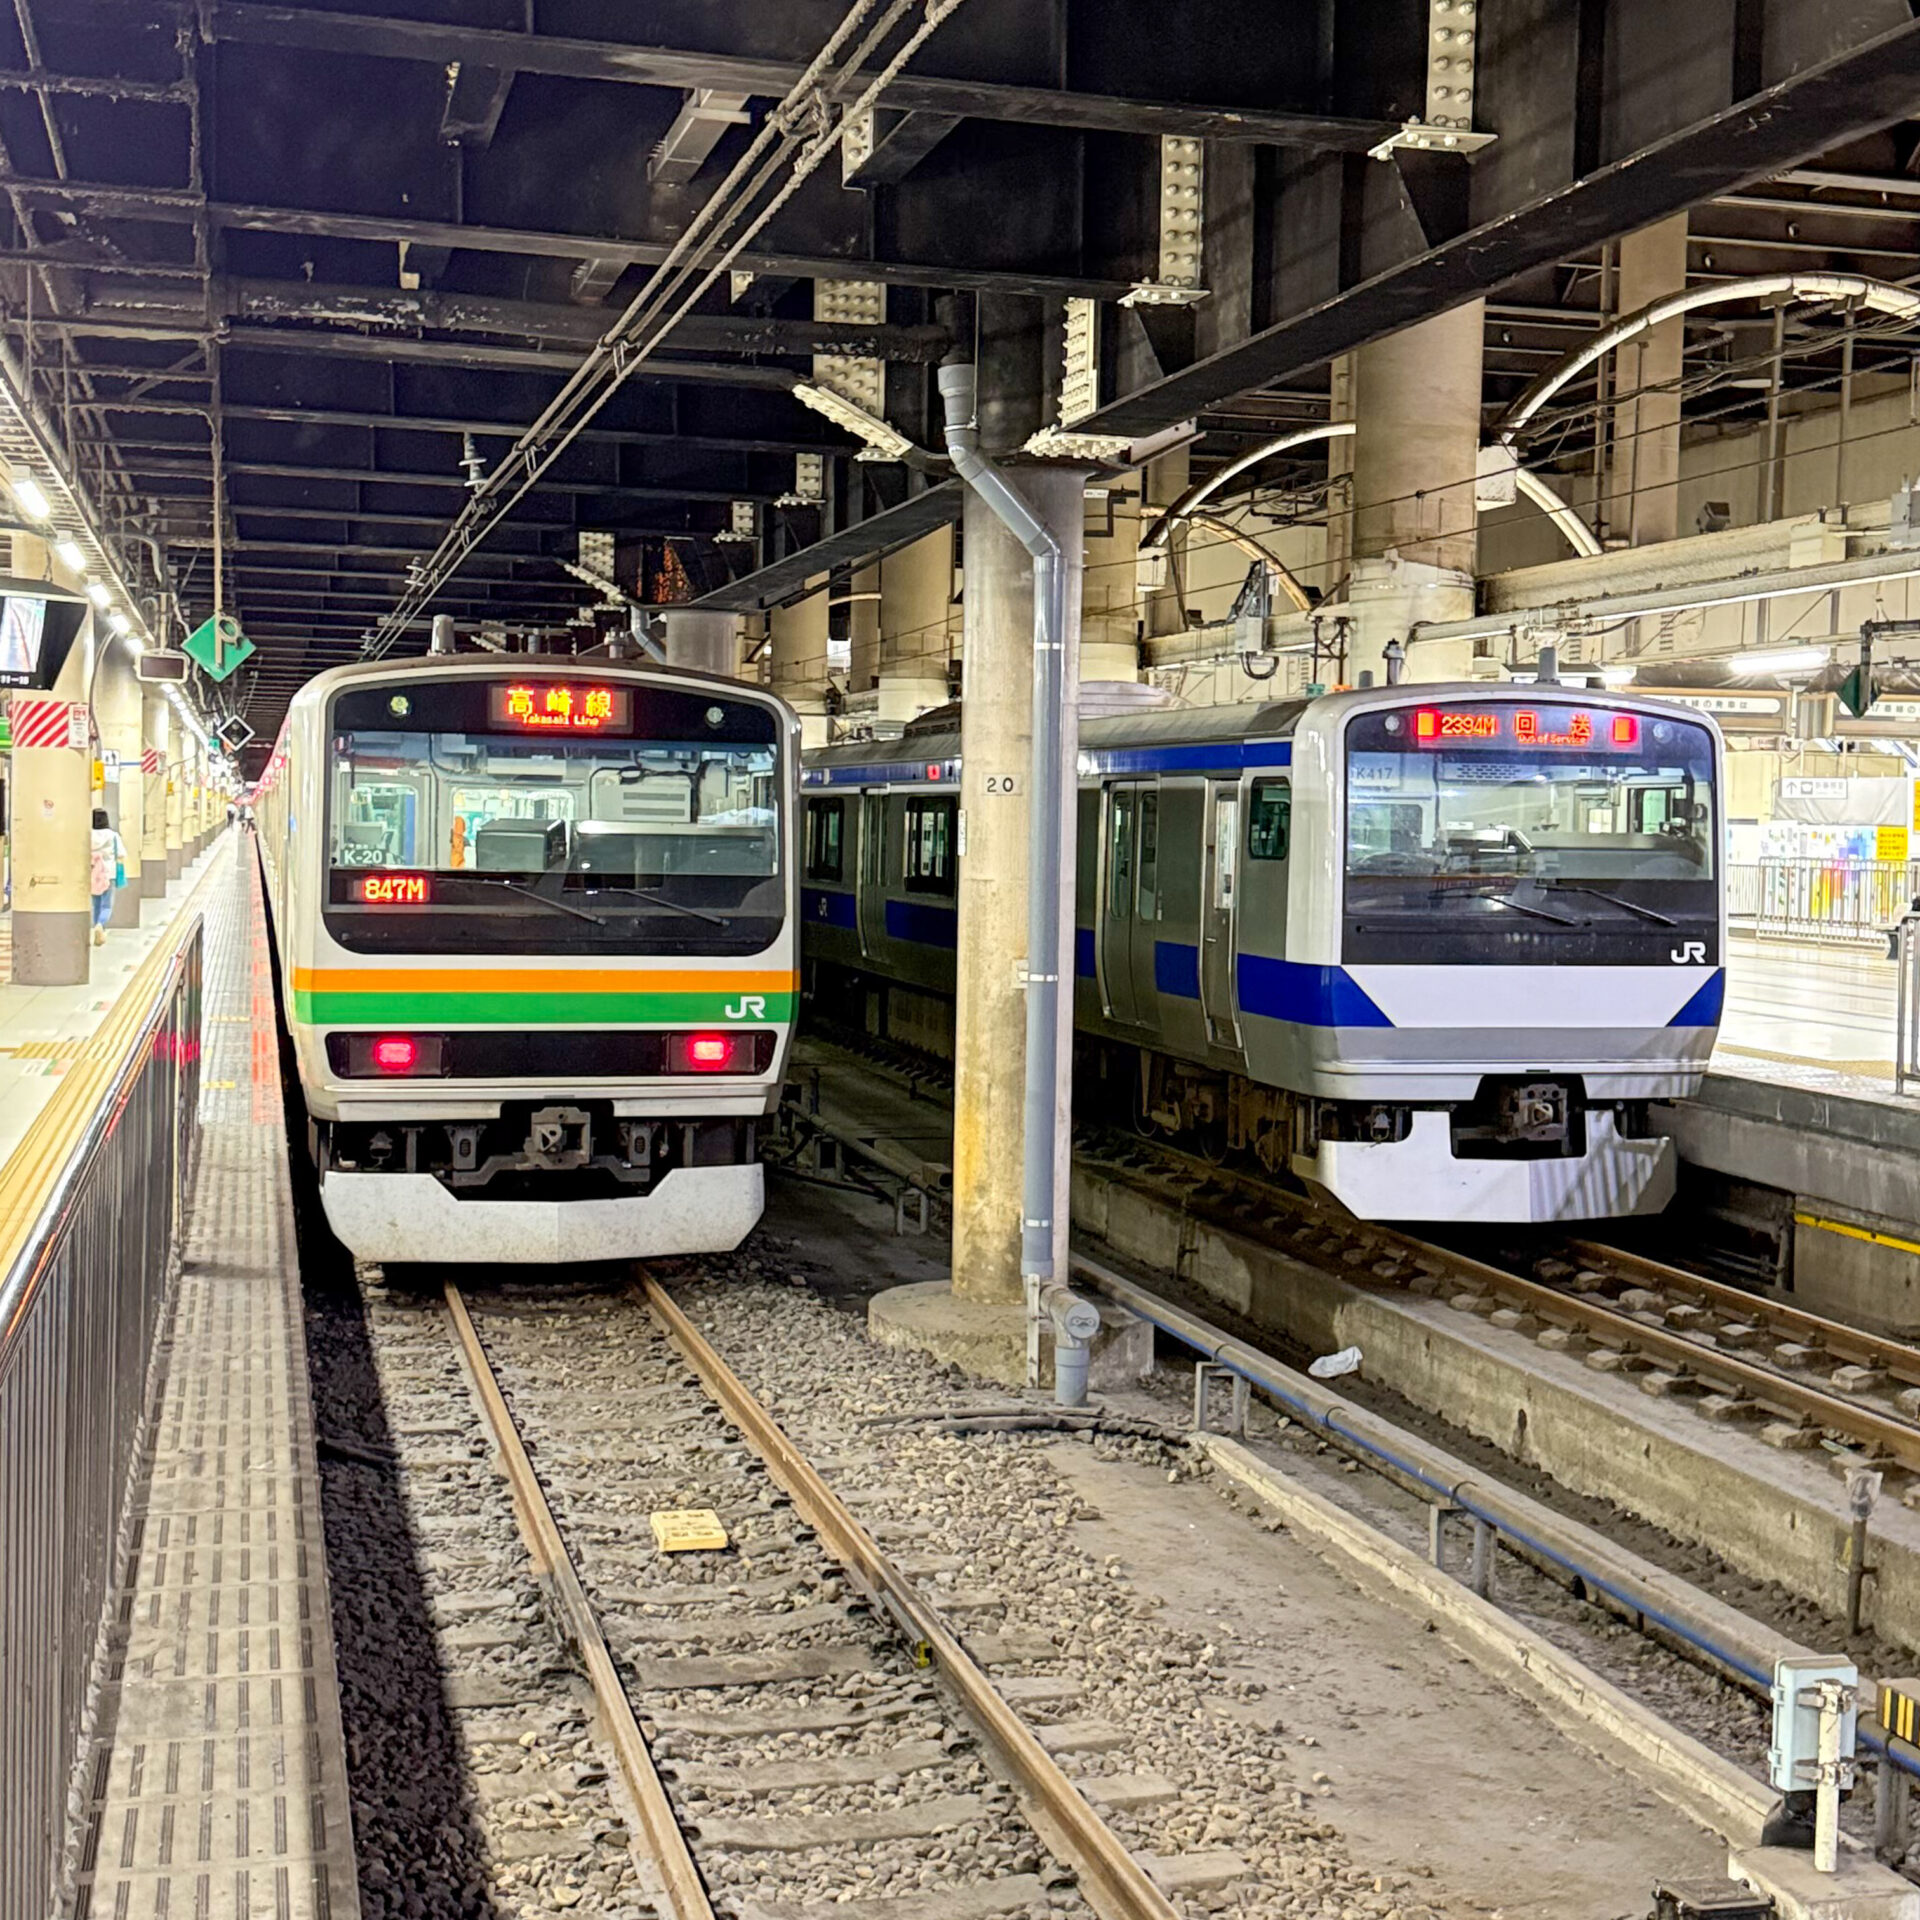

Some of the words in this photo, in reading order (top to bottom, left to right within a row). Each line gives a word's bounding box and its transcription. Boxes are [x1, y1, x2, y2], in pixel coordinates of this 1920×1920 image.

[507, 687, 612, 718] 高崎線
[522, 713, 571, 725] Takasaki
[573, 714, 600, 725] Line
[1441, 715, 1497, 736] 2394M
[1513, 711, 1592, 738] 回送
[1537, 733, 1549, 745] of
[1550, 733, 1587, 745] Service
[1356, 767, 1393, 779] K417
[986, 777, 1014, 793] 20
[344, 849, 383, 864] K-20
[365, 878, 424, 900] 847M
[1671, 941, 1706, 964] JR
[725, 995, 766, 1019] JR
